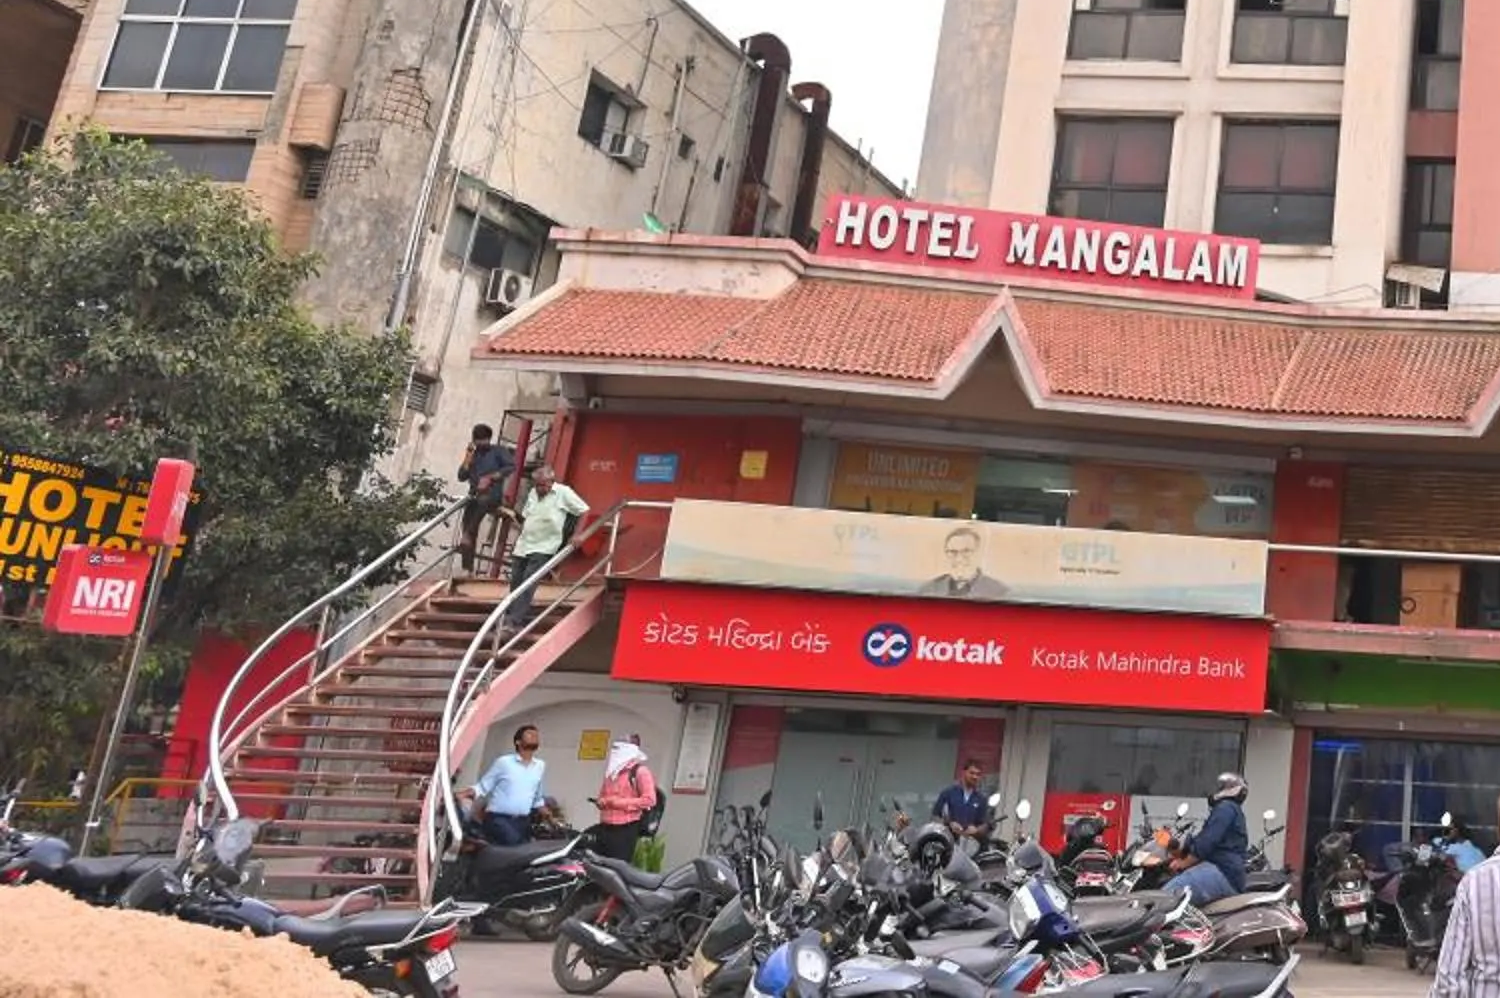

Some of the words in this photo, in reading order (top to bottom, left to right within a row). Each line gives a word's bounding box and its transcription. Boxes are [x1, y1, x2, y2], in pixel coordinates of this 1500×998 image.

[834, 199, 979, 260] HOTEL
[1004, 219, 1250, 289] MANGALAM
[71, 575, 137, 611] NRI
[916, 635, 1005, 665] kotak
[1031, 648, 1090, 670] Kotak
[1096, 652, 1192, 675] Mahindra
[1197, 656, 1246, 678] Bank
